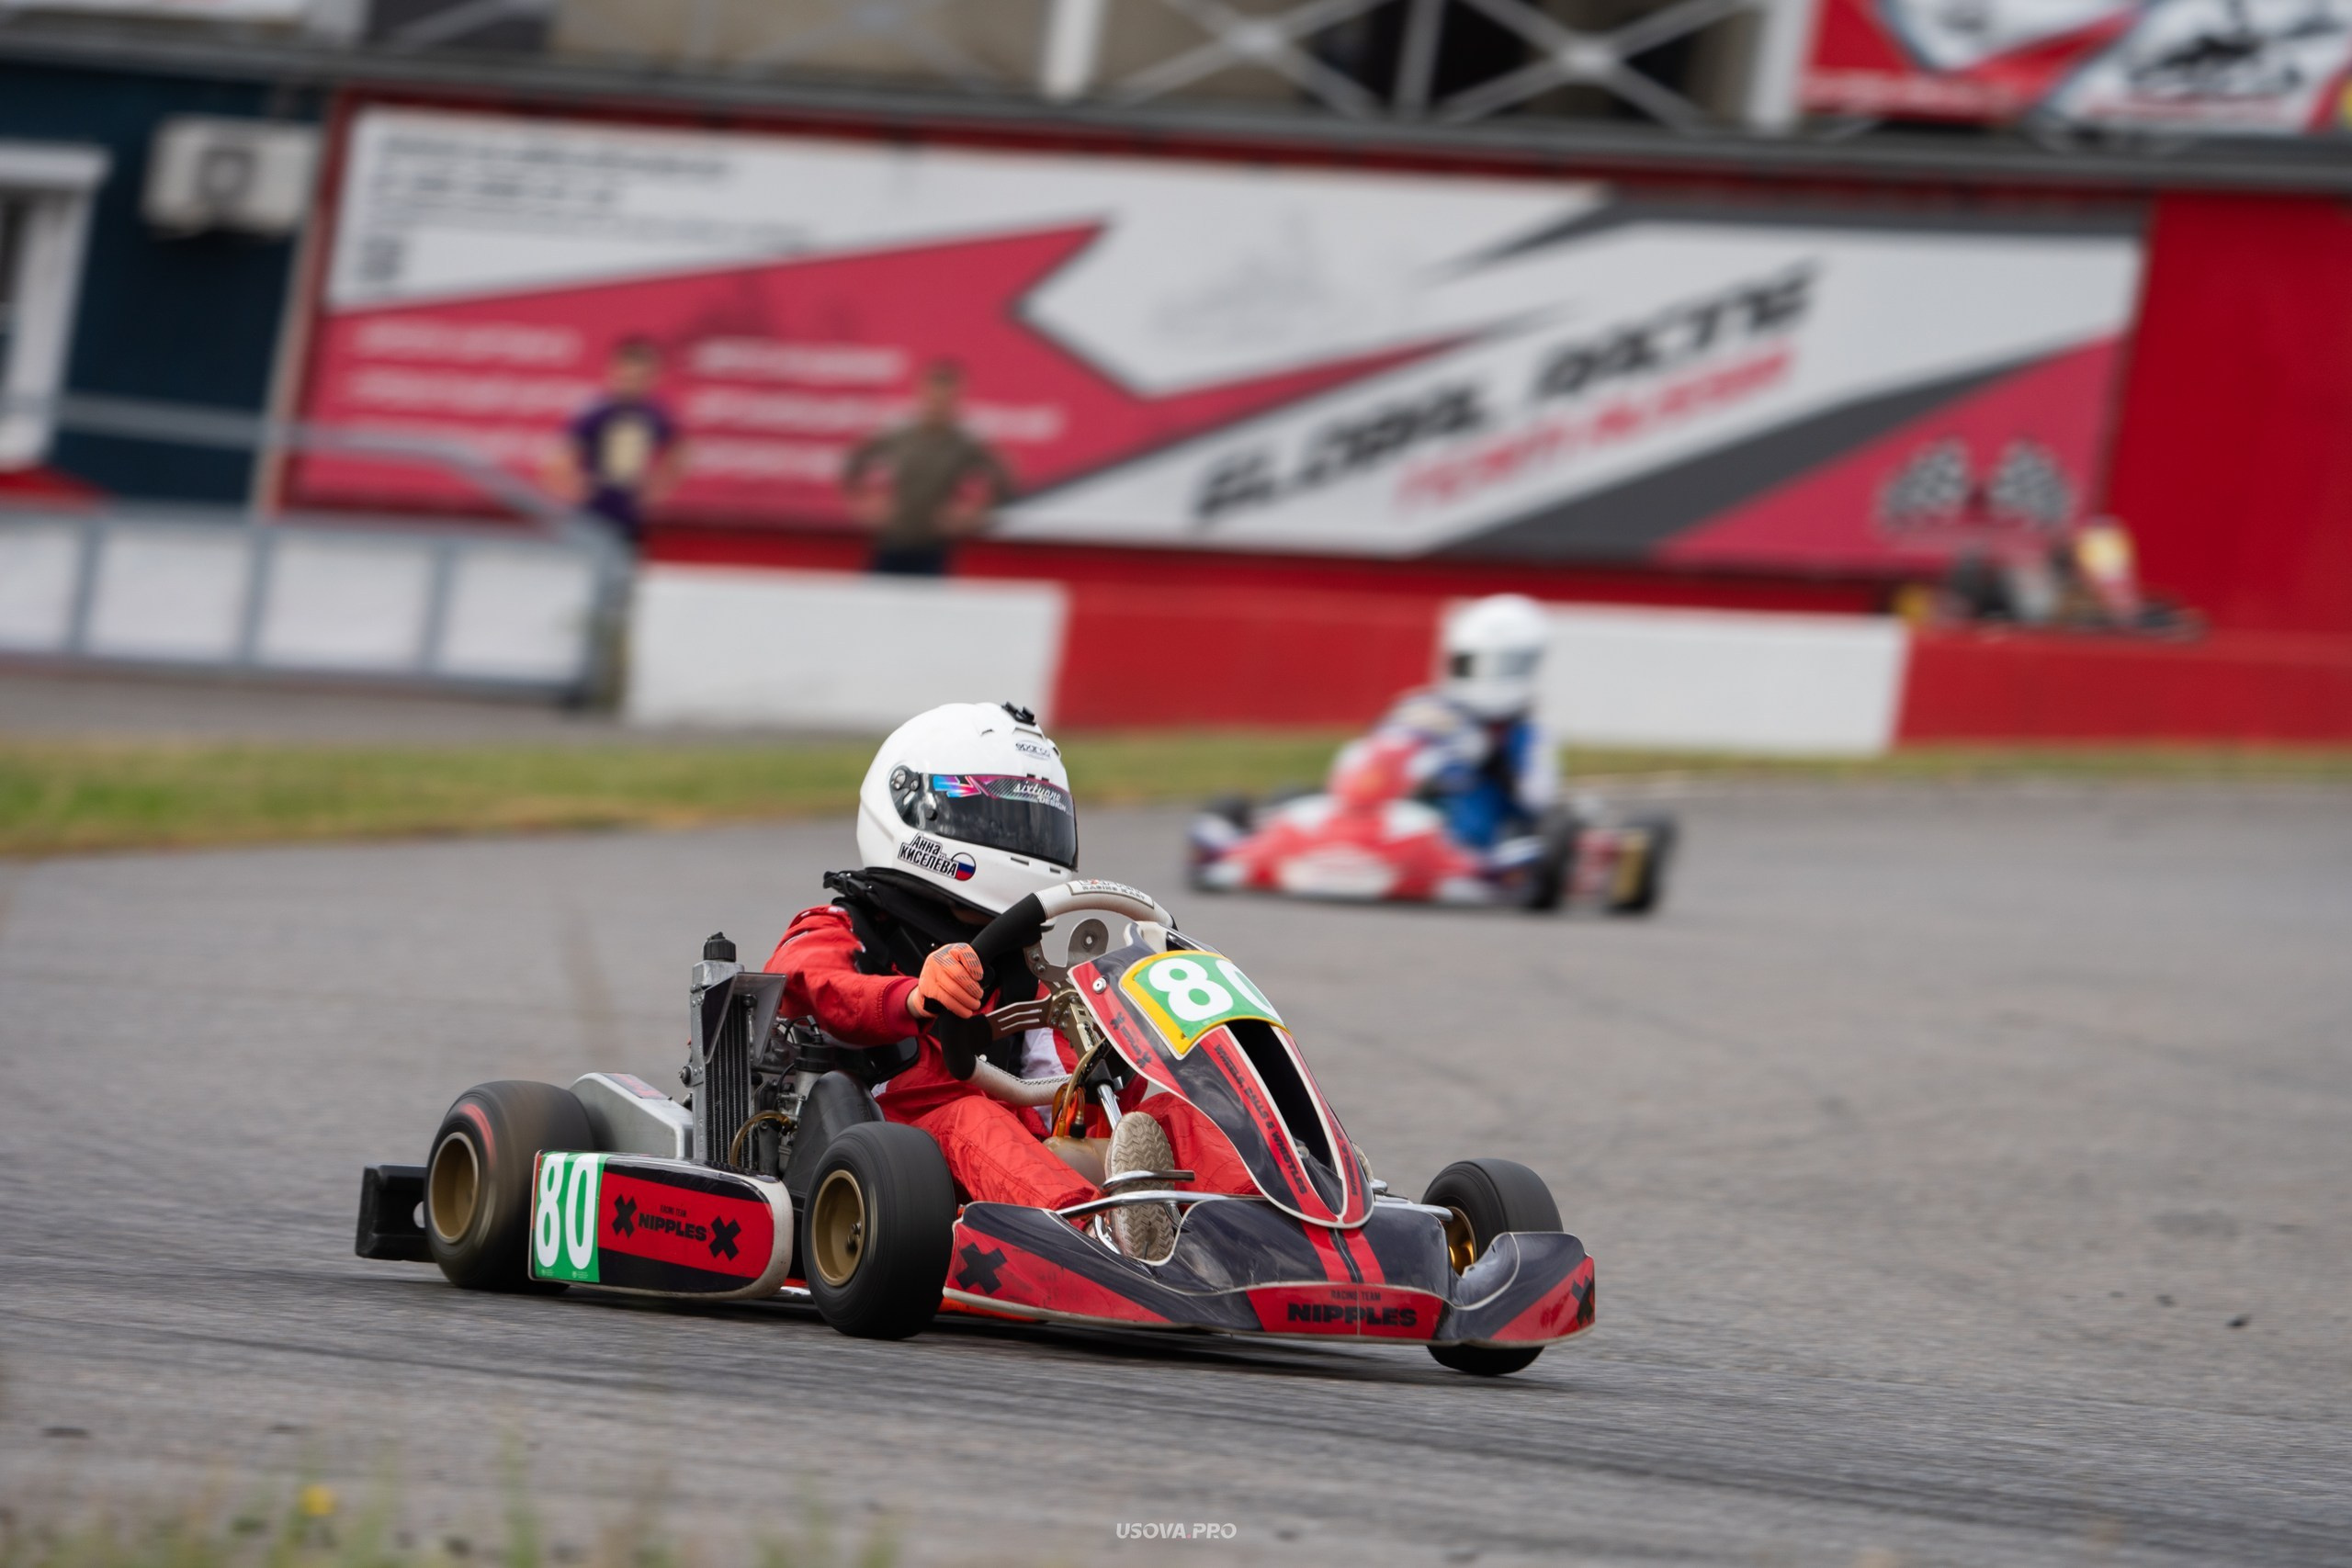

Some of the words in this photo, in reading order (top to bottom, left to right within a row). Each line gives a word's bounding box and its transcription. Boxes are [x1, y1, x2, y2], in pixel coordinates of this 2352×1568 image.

[1013, 780, 1061, 802] sixtyone
[911, 835, 942, 855] Анна
[900, 844, 957, 876] КИСЕЛЁВА
[1272, 1131, 1307, 1194] WHISTLES
[536, 1153, 597, 1270] 80
[638, 1213, 707, 1242] NIPPLES
[1330, 1290, 1358, 1301] RACING
[1361, 1291, 1381, 1302] TEAM
[1287, 1303, 1418, 1327] NIPPLES
